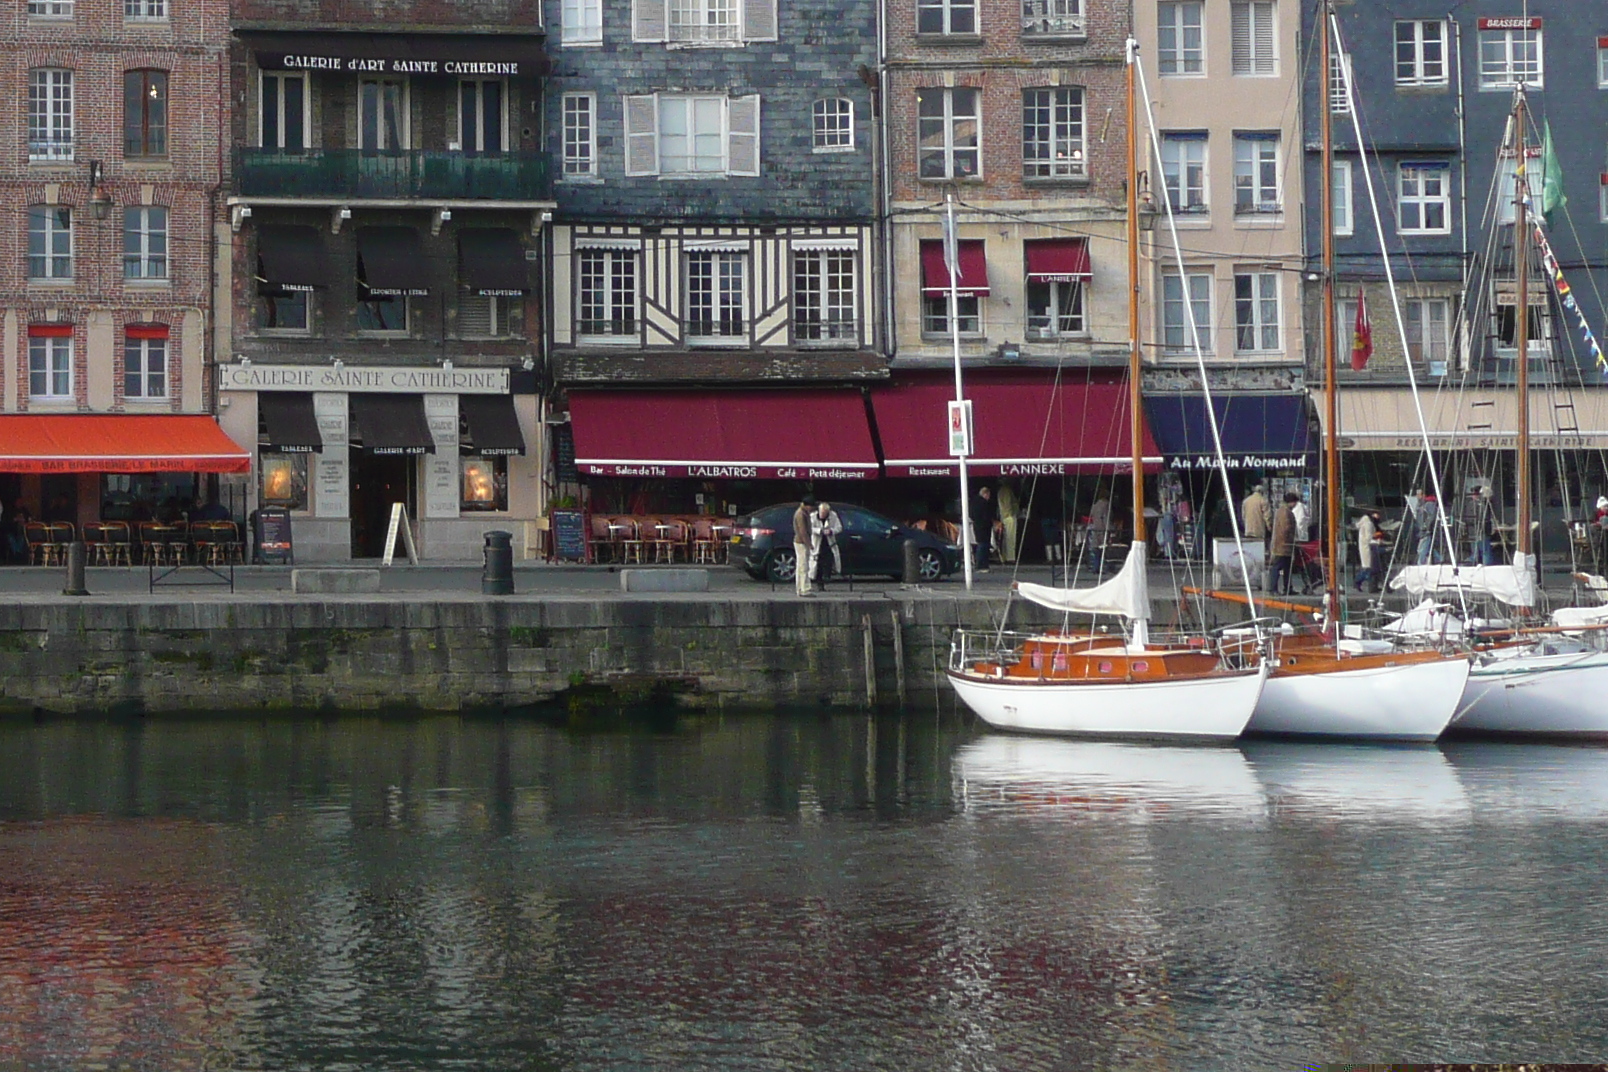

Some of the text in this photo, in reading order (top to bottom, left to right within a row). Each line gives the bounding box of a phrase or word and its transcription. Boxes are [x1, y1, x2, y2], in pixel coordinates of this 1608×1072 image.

[1486, 18, 1533, 28] BRASSERIE
[283, 54, 519, 75] GALERIE d'ART SAINTE CATHERINE
[232, 369, 495, 388] GALERIE SAINTE CATHERINE
[1480, 437, 1520, 447] SAINT
[42, 460, 65, 470] BAR
[68, 460, 130, 470] BRASSERIE
[132, 460, 145, 470] LE
[149, 459, 185, 470] MARIN
[1170, 454, 1306, 469] Au Marin Normand
[590, 465, 604, 475] Bar
[615, 465, 637, 476] Salon
[638, 466, 650, 476] de
[651, 466, 666, 477] Thé
[688, 465, 757, 478] L'ALBATROS
[777, 467, 796, 478] Café
[809, 468, 828, 478] Petit
[908, 464, 1066, 476] Restaurant L'ANNEXE
